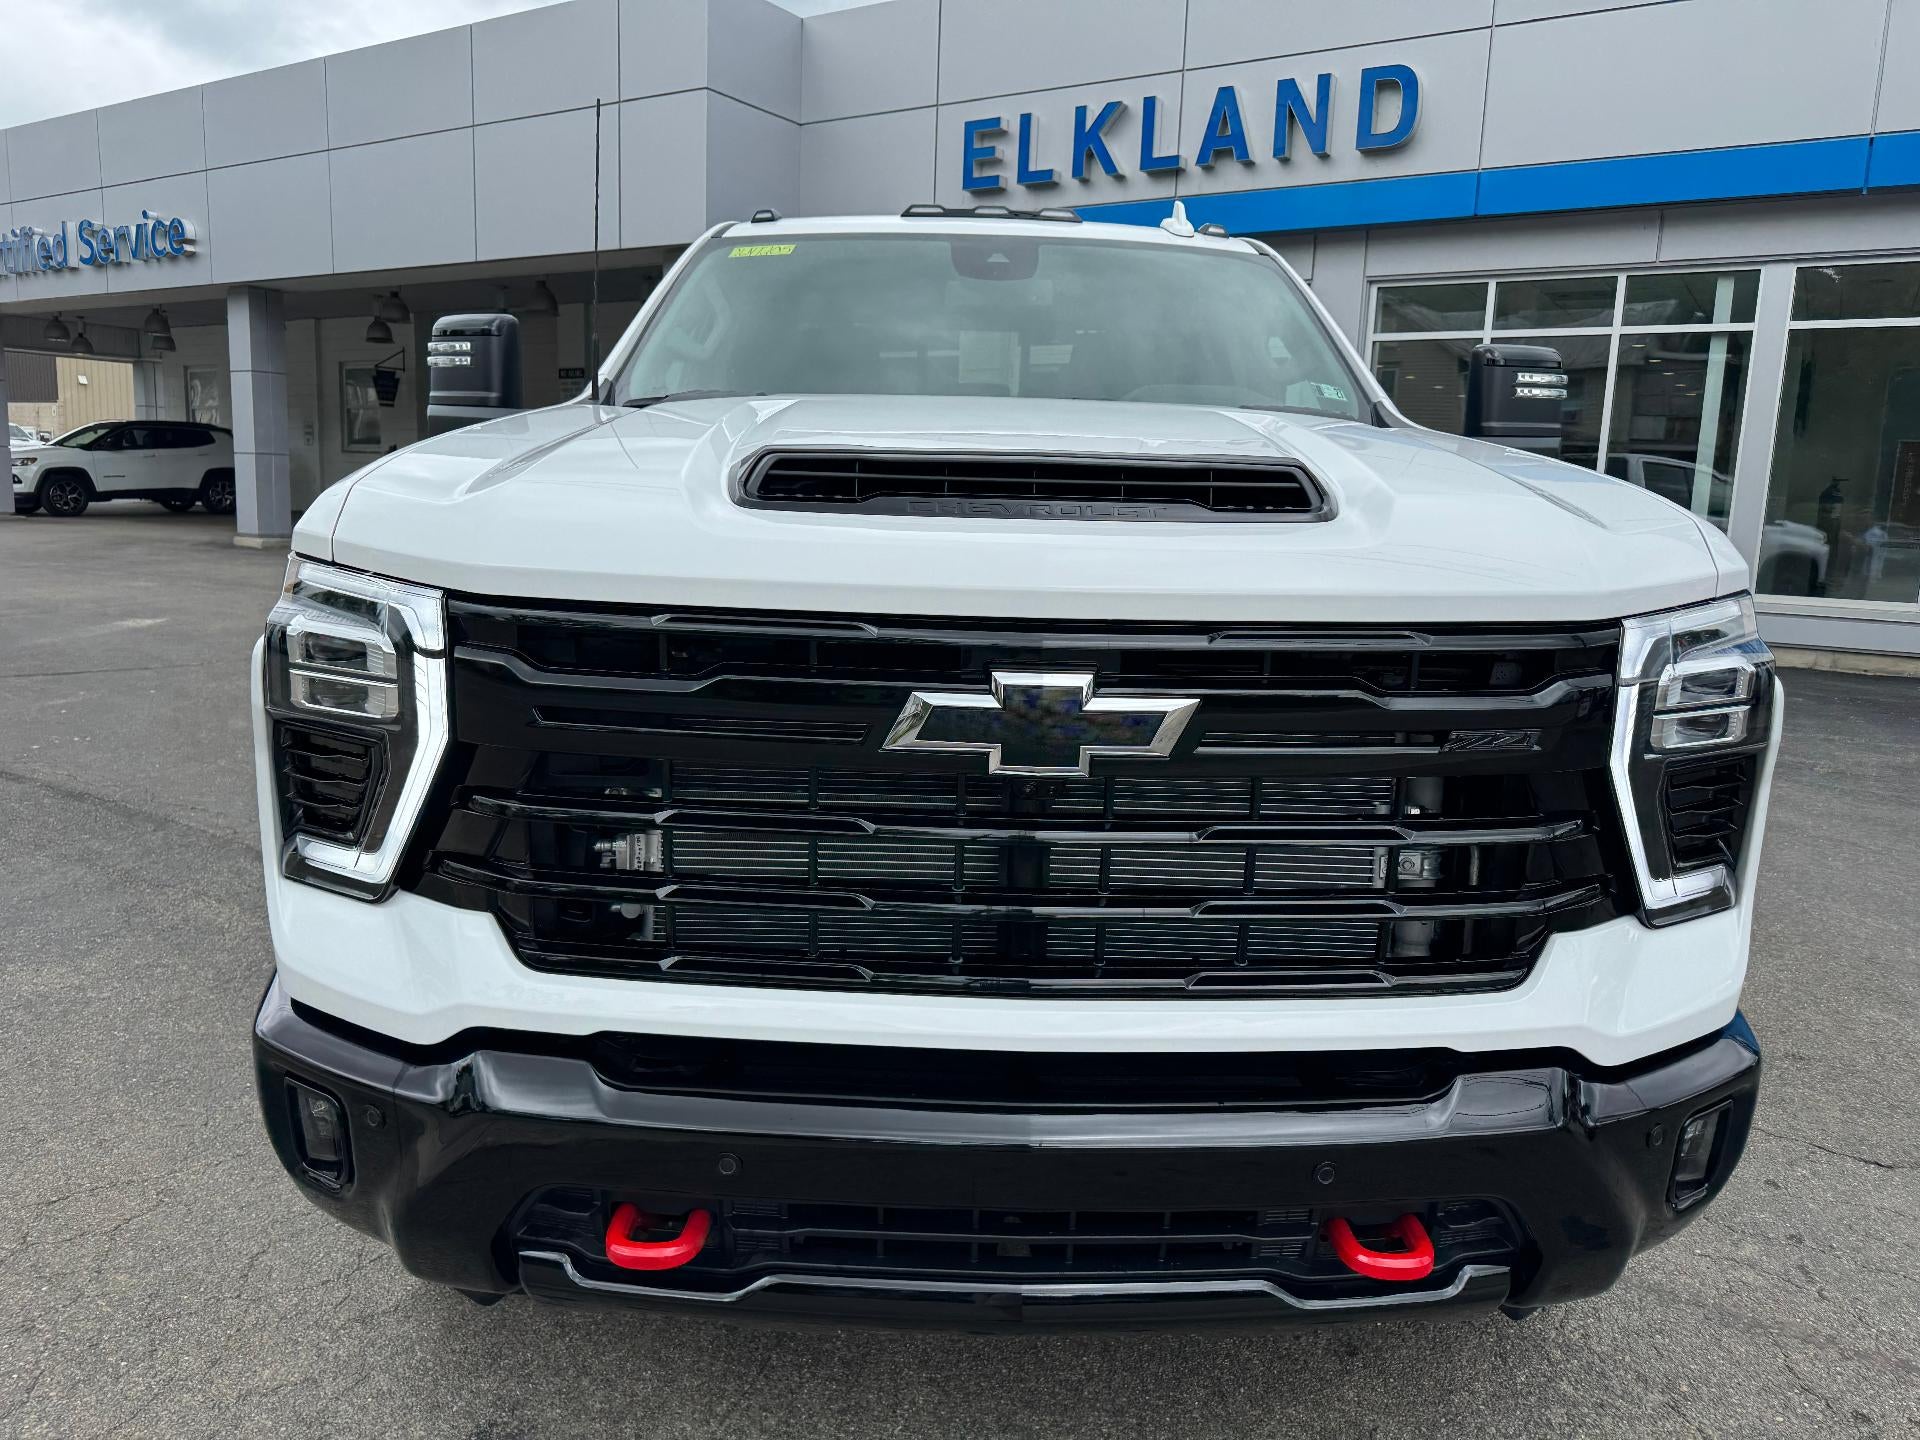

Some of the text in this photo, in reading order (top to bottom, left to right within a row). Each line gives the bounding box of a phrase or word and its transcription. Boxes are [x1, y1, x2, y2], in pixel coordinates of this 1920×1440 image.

[962, 63, 1420, 192] ELKLAND
[0, 209, 189, 273] tified Service
[906, 501, 1168, 519] CHEVROLET
